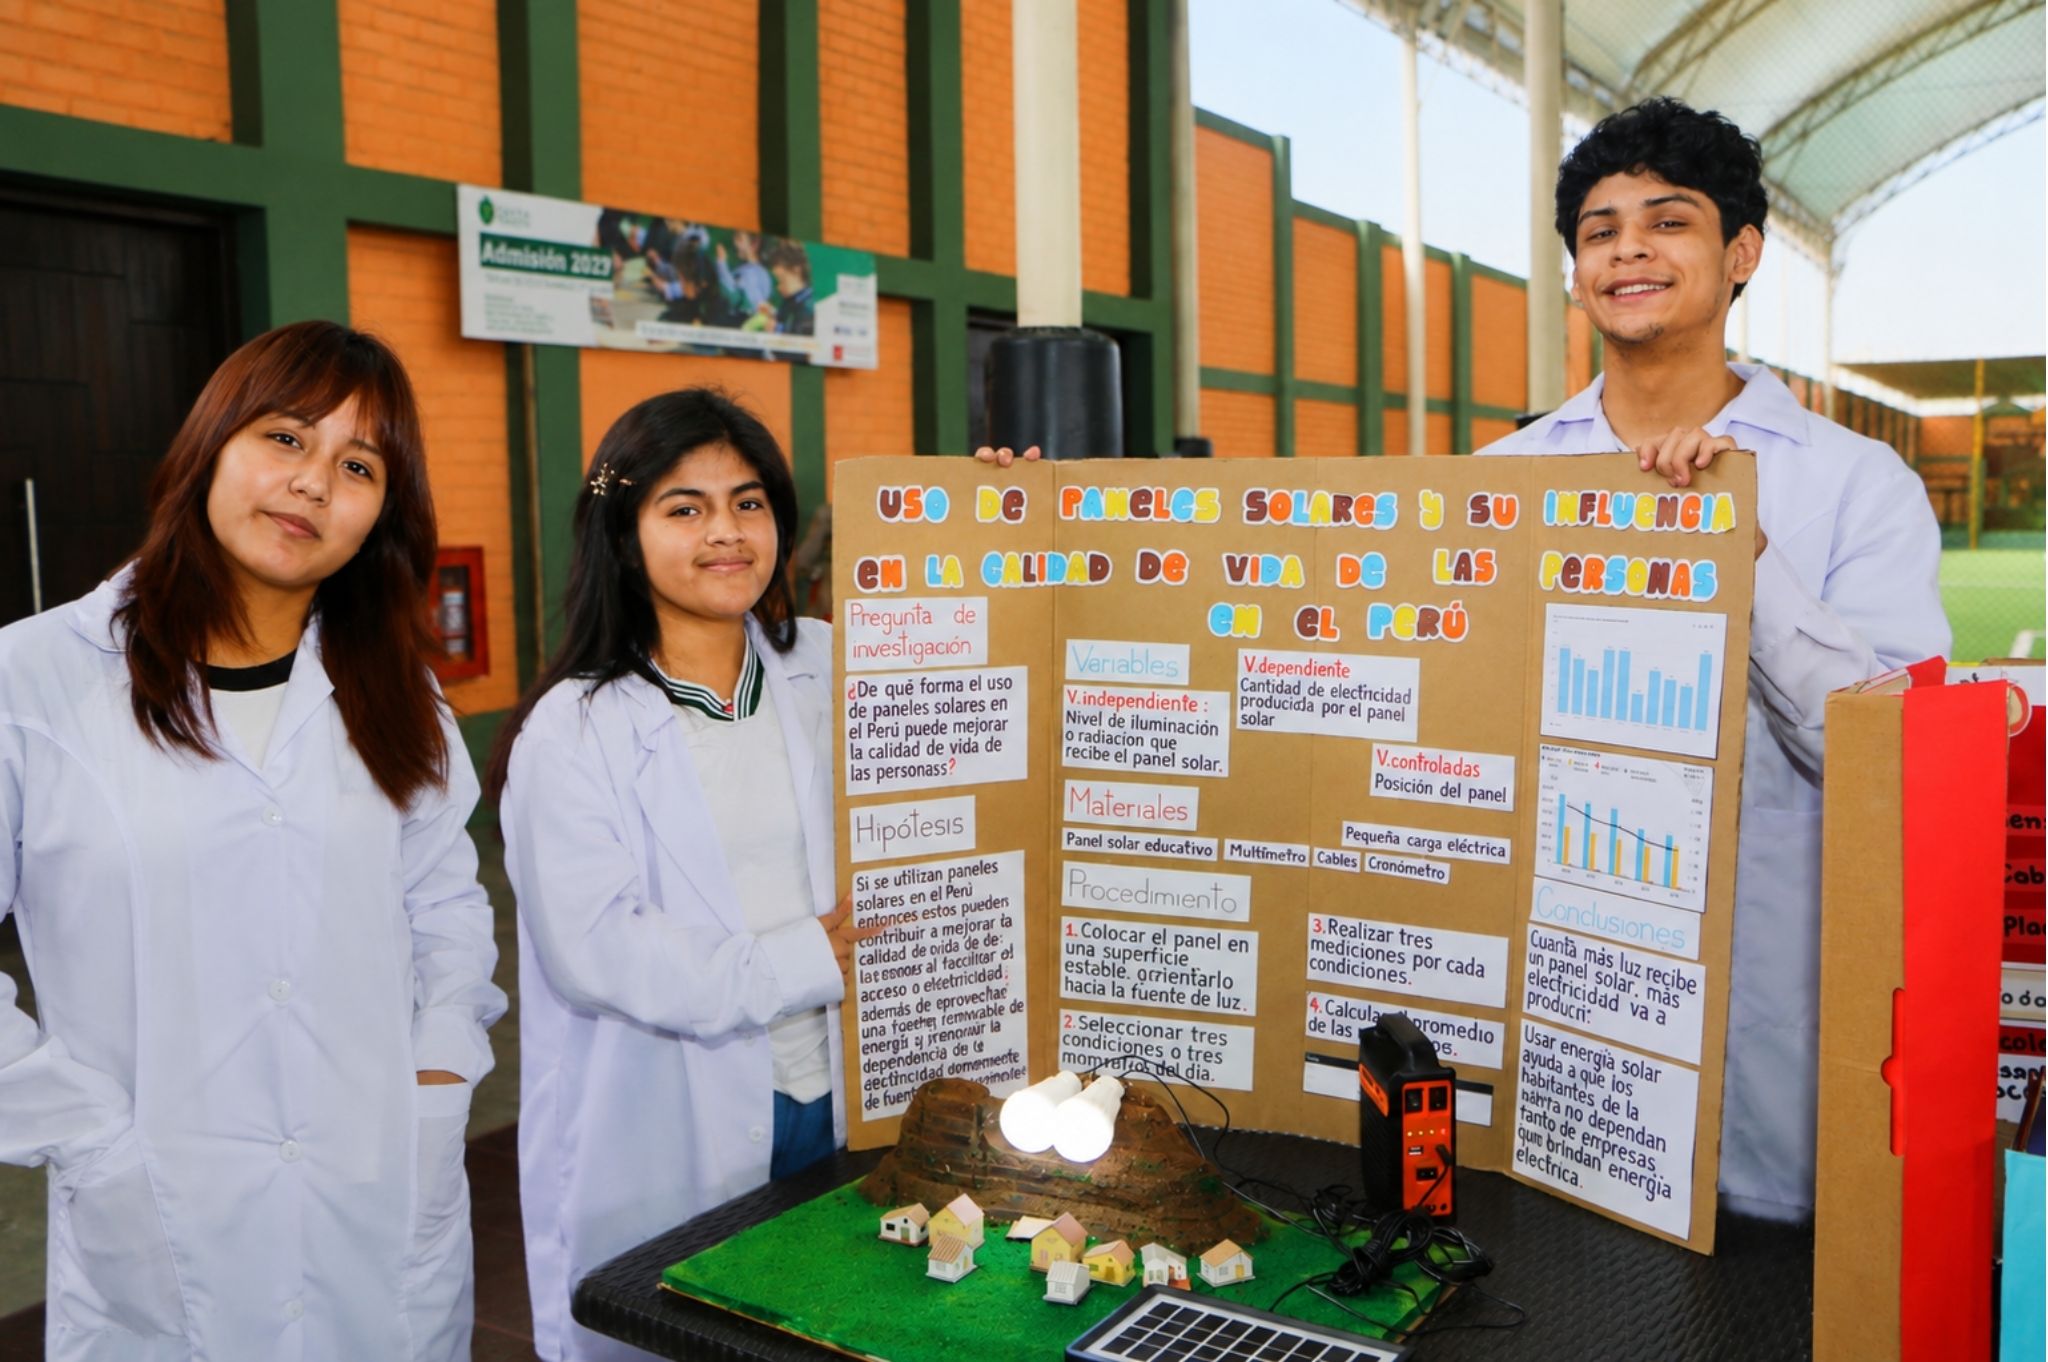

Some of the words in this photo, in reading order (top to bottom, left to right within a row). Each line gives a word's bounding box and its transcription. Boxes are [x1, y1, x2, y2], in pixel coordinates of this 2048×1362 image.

[482, 240, 567, 271] Admisión
[878, 486, 949, 523] USO
[1467, 490, 1518, 530] SU
[925, 555, 964, 588] LA
[980, 550, 1112, 587] CALIDAD
[1222, 552, 1305, 588] VIDA
[1432, 547, 1496, 585] LAS
[851, 603, 933, 636] Pregunta
[954, 604, 976, 624] de
[853, 631, 971, 664] investigación
[1072, 645, 1179, 678] Variables
[848, 680, 878, 700] ¿De
[885, 679, 914, 700] qué
[920, 677, 964, 694] forma
[969, 675, 982, 691] el
[987, 676, 1013, 690] uso
[1240, 677, 1301, 695] Cantidad
[1308, 682, 1324, 697] de
[848, 702, 867, 719] de
[873, 700, 929, 722] paneles
[934, 697, 986, 714] solares
[991, 698, 1008, 711] en
[1066, 710, 1102, 726] Nivel
[1108, 713, 1126, 728] de
[1130, 714, 1219, 736] iluminación
[1241, 711, 1275, 727] solar
[1322, 701, 1344, 718] por
[1350, 702, 1362, 717] el
[1367, 706, 1405, 723] panel
[849, 722, 861, 739] el
[868, 722, 899, 738] Perú
[905, 719, 948, 741] puede
[953, 717, 1008, 736] mejorar
[1065, 730, 1074, 741] o
[1150, 736, 1177, 752] que
[850, 743, 863, 760] la
[868, 741, 920, 759] calidad
[926, 738, 944, 755] de
[949, 738, 979, 754] vida
[985, 736, 1002, 752] de
[1065, 745, 1110, 762] recibe
[1114, 749, 1127, 763] el
[1133, 752, 1175, 769] panel
[1182, 754, 1222, 773] solar.
[851, 764, 870, 781] las
[1375, 773, 1433, 795] Posición
[1440, 782, 1461, 798] del
[1468, 787, 1507, 804] panel
[1070, 787, 1188, 821] Materiales
[857, 808, 965, 853] Hipótesis
[1346, 827, 1400, 846] Pequeña
[1407, 834, 1443, 851] carga
[1447, 839, 1506, 858] eléctrica
[1067, 832, 1102, 848] Panel
[1107, 836, 1140, 850] solar
[1144, 838, 1213, 857] educativo
[1317, 851, 1358, 868] Cables
[1369, 856, 1445, 880] Cronómetro
[856, 876, 869, 892] Si
[874, 877, 889, 890] se
[894, 868, 943, 887] utilizan
[948, 859, 999, 883] paneles
[856, 894, 905, 912] solares
[909, 892, 926, 904] en
[930, 886, 943, 901] el
[1069, 869, 1237, 914] Procedimiento
[857, 909, 918, 929] entonces
[922, 904, 957, 920] estos
[930, 926, 942, 938] a
[942, 918, 996, 939] mejorar
[1536, 885, 1686, 949] Conclusiones
[859, 947, 906, 966] calidad
[912, 944, 926, 958] de
[964, 936, 979, 950] de
[1152, 928, 1166, 945] el
[1174, 932, 1221, 952] panel
[1228, 939, 1249, 953] en
[1399, 928, 1433, 950] tres
[926, 958, 937, 973] al
[1065, 942, 1095, 957] una
[1103, 946, 1189, 966] superficie
[1311, 938, 1406, 964] mediciones
[1413, 954, 1442, 971] por
[1446, 958, 1485, 978] cada
[1529, 951, 1544, 967] un
[1549, 956, 1588, 980] panel
[1309, 957, 1412, 986] condiciones.
[1620, 951, 1641, 978] luz
[1646, 968, 1697, 995] recibe
[861, 985, 907, 1002] acceso
[912, 983, 920, 994] o
[1064, 976, 1106, 996] hacia
[1111, 981, 1125, 998] la
[1191, 989, 1211, 1007] de
[1216, 991, 1248, 1012] luz.
[861, 998, 911, 1022] además
[916, 998, 931, 1014] de
[862, 1024, 886, 1039] una
[1009, 998, 1024, 1014] de
[1630, 1001, 1649, 1021] va
[1655, 1010, 1666, 1025] a
[990, 1020, 1001, 1033] la
[1191, 1027, 1228, 1046] tres
[1308, 1017, 1326, 1034] de
[1331, 1020, 1352, 1038] las
[1062, 1033, 1164, 1058] condiciones
[1171, 1046, 1182, 1059] o
[1187, 1046, 1223, 1064] tres
[1525, 1024, 1556, 1049] Usar
[1622, 1060, 1662, 1083] solar
[1156, 1060, 1180, 1077] del
[1522, 1049, 1563, 1074] ayuda
[1567, 1064, 1576, 1079] a
[1580, 1069, 1605, 1089] que
[864, 1092, 879, 1111] de
[1522, 1068, 1595, 1107] habitantes
[1602, 1095, 1620, 1116] de
[1627, 1100, 1639, 1121] la
[1520, 1105, 1556, 1132] tanto
[1560, 1121, 1577, 1140] de
[1582, 1131, 1656, 1172] empresas
[1565, 1104, 1583, 1122] no
[1588, 1111, 1667, 1152] dependan
[1546, 1134, 1601, 1172] brindan
